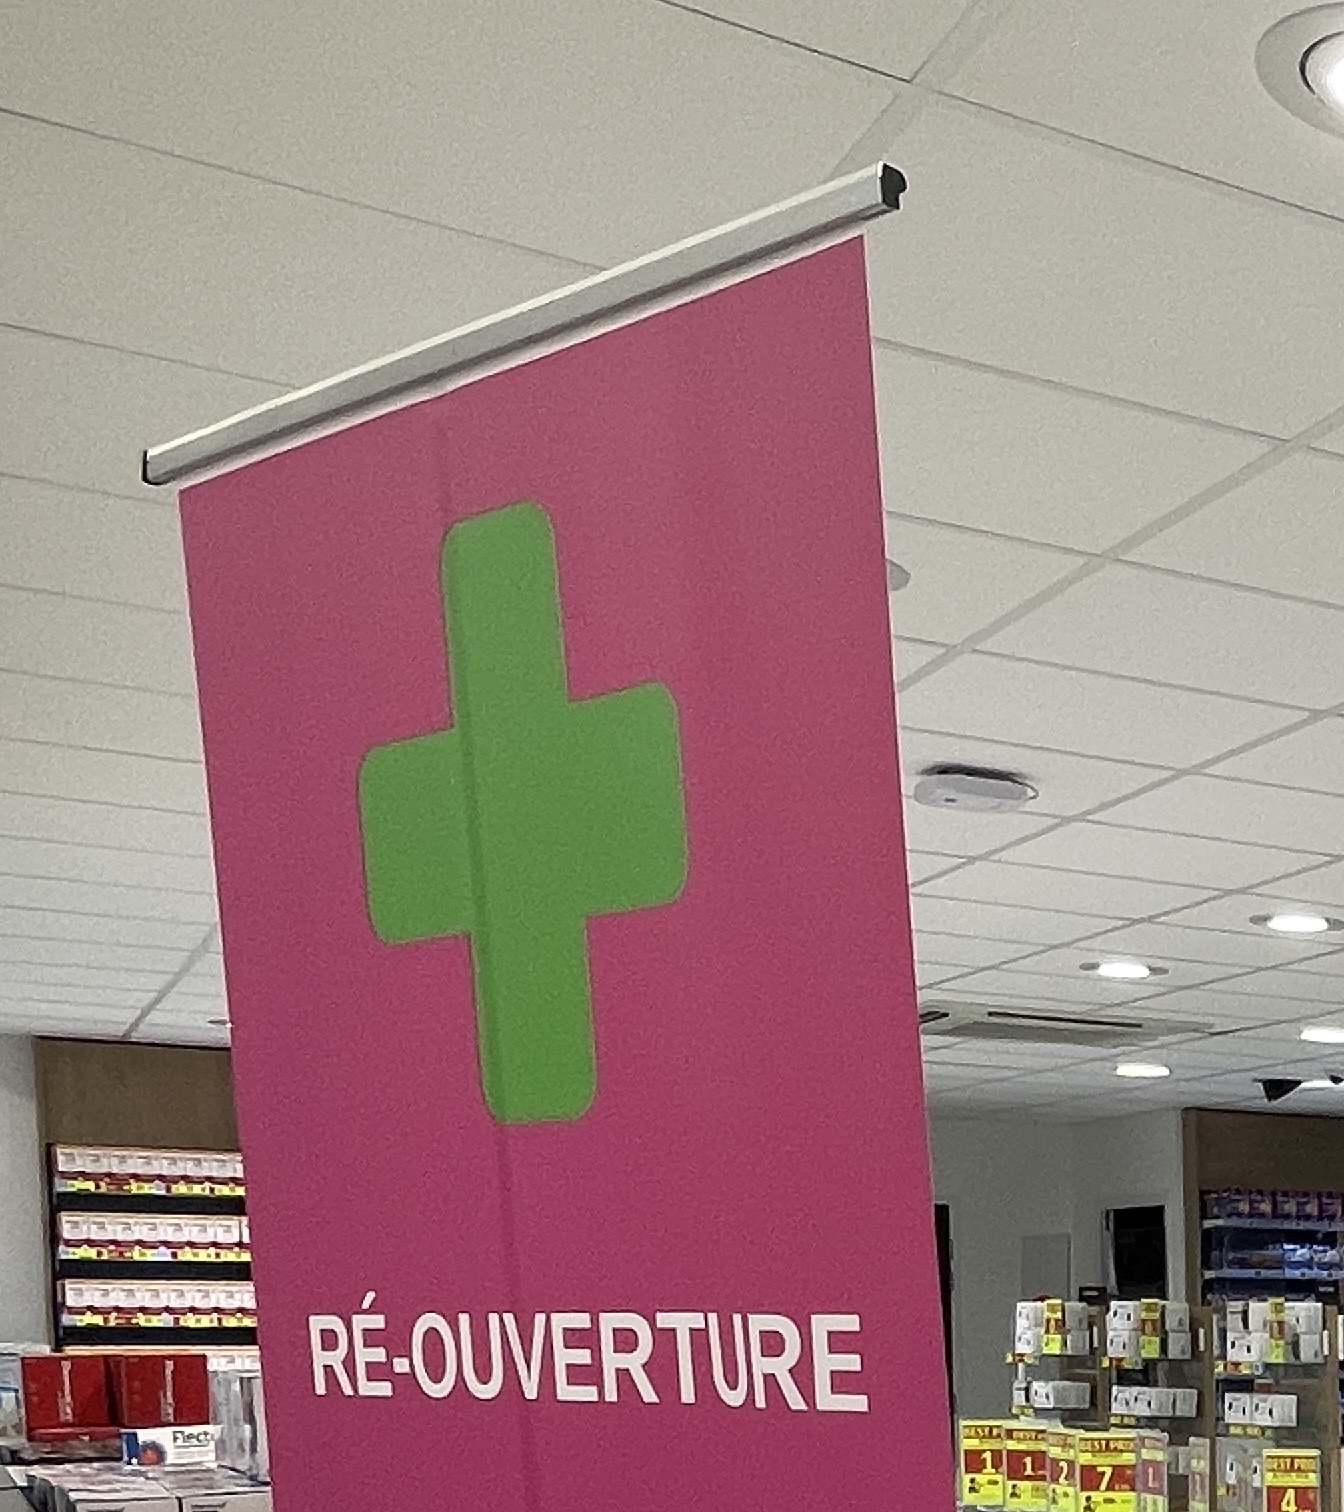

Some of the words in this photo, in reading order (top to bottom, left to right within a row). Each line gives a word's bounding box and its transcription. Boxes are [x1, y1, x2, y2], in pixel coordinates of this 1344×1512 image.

[308, 1291, 870, 1413] RÉ-OUVERTURE
[980, 1450, 996, 1474] 1
[1022, 1456, 1036, 1476] 1
[1097, 1466, 1113, 1491] 7
